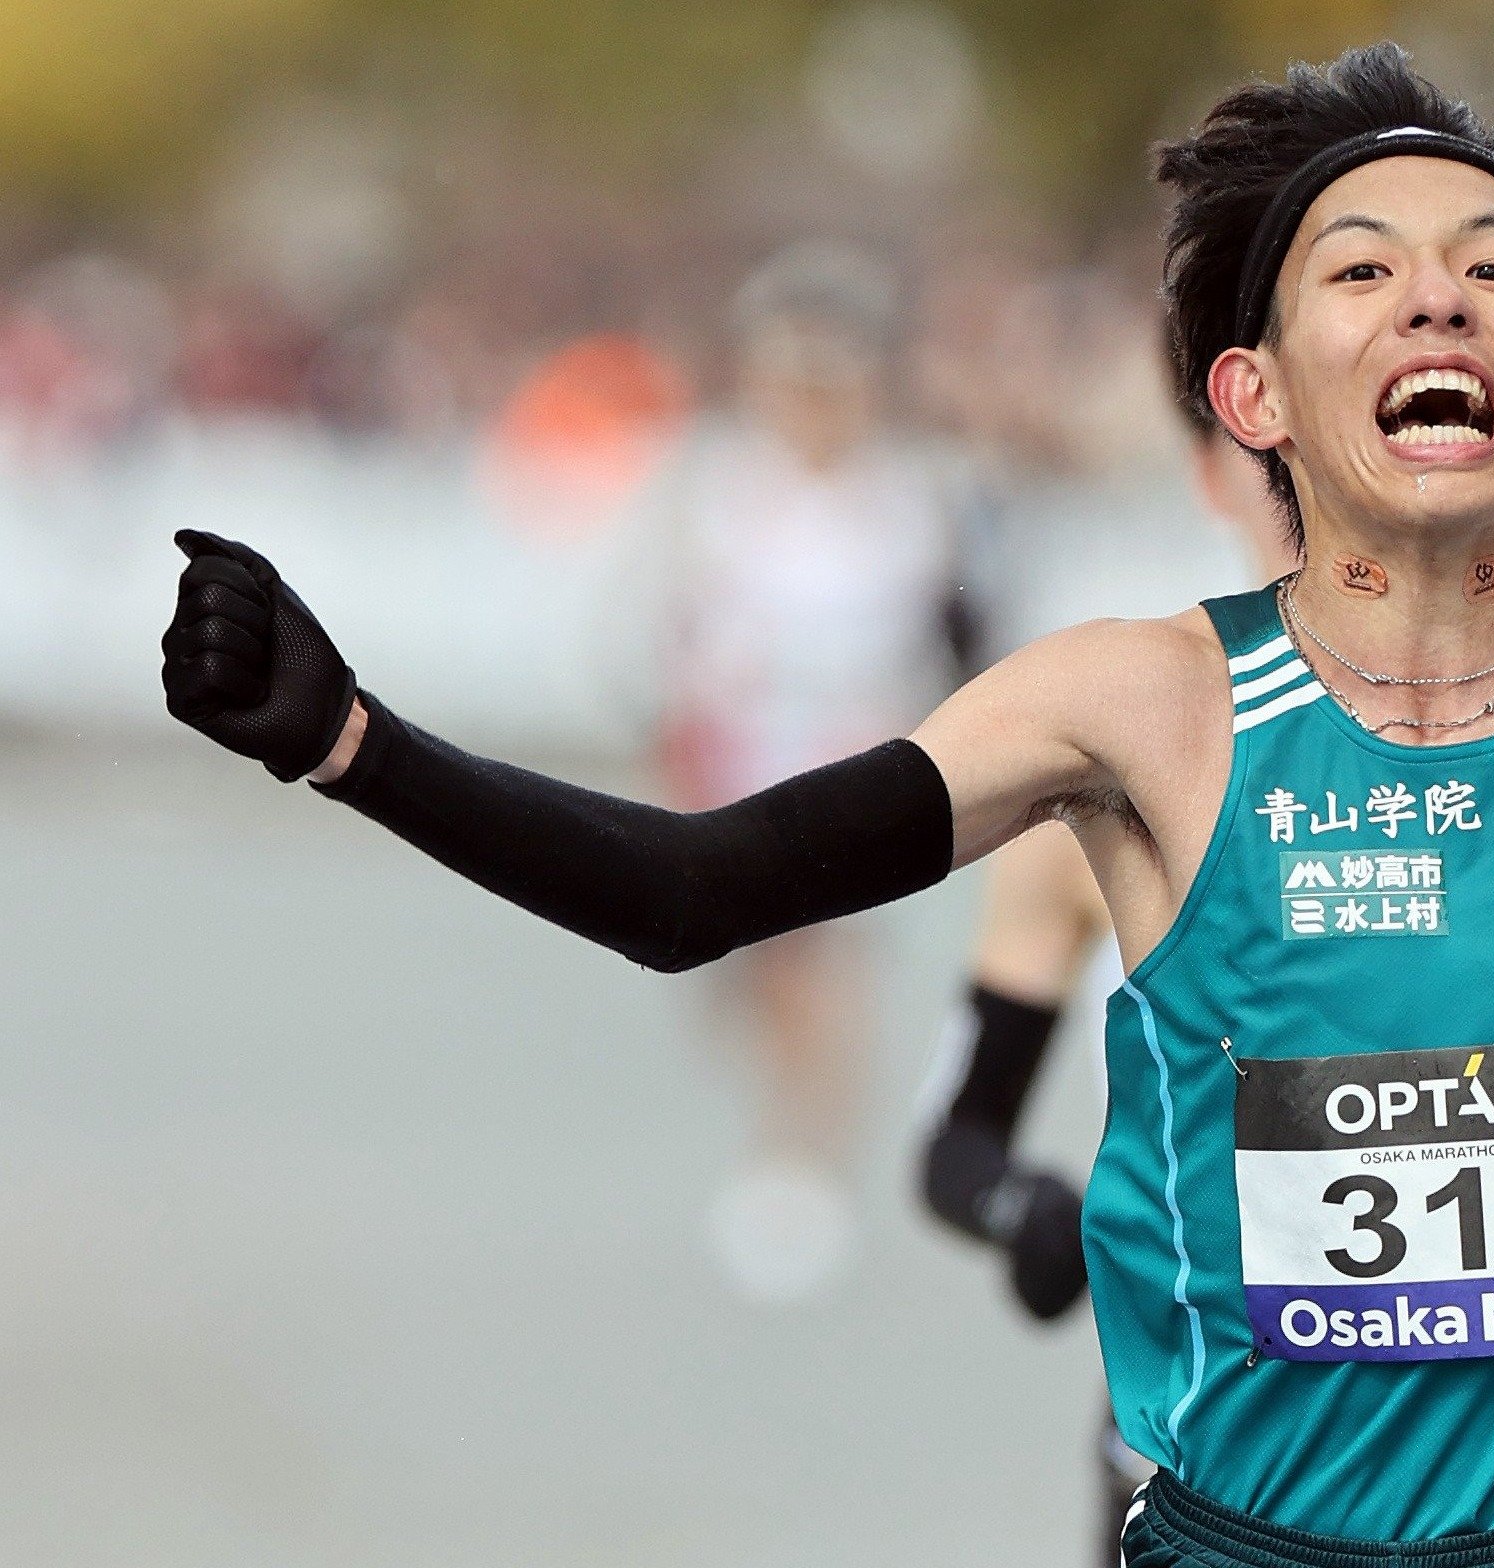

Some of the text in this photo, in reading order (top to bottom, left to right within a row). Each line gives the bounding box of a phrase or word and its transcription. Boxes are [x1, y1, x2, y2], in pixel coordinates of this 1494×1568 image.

[1255, 780, 1482, 844] 青山学院
[1340, 855, 1442, 889] 妙高市
[1335, 898, 1440, 933] 水上村
[1360, 1149, 1416, 1165] OSAKA
[1280, 1295, 1470, 1348] Osaka
